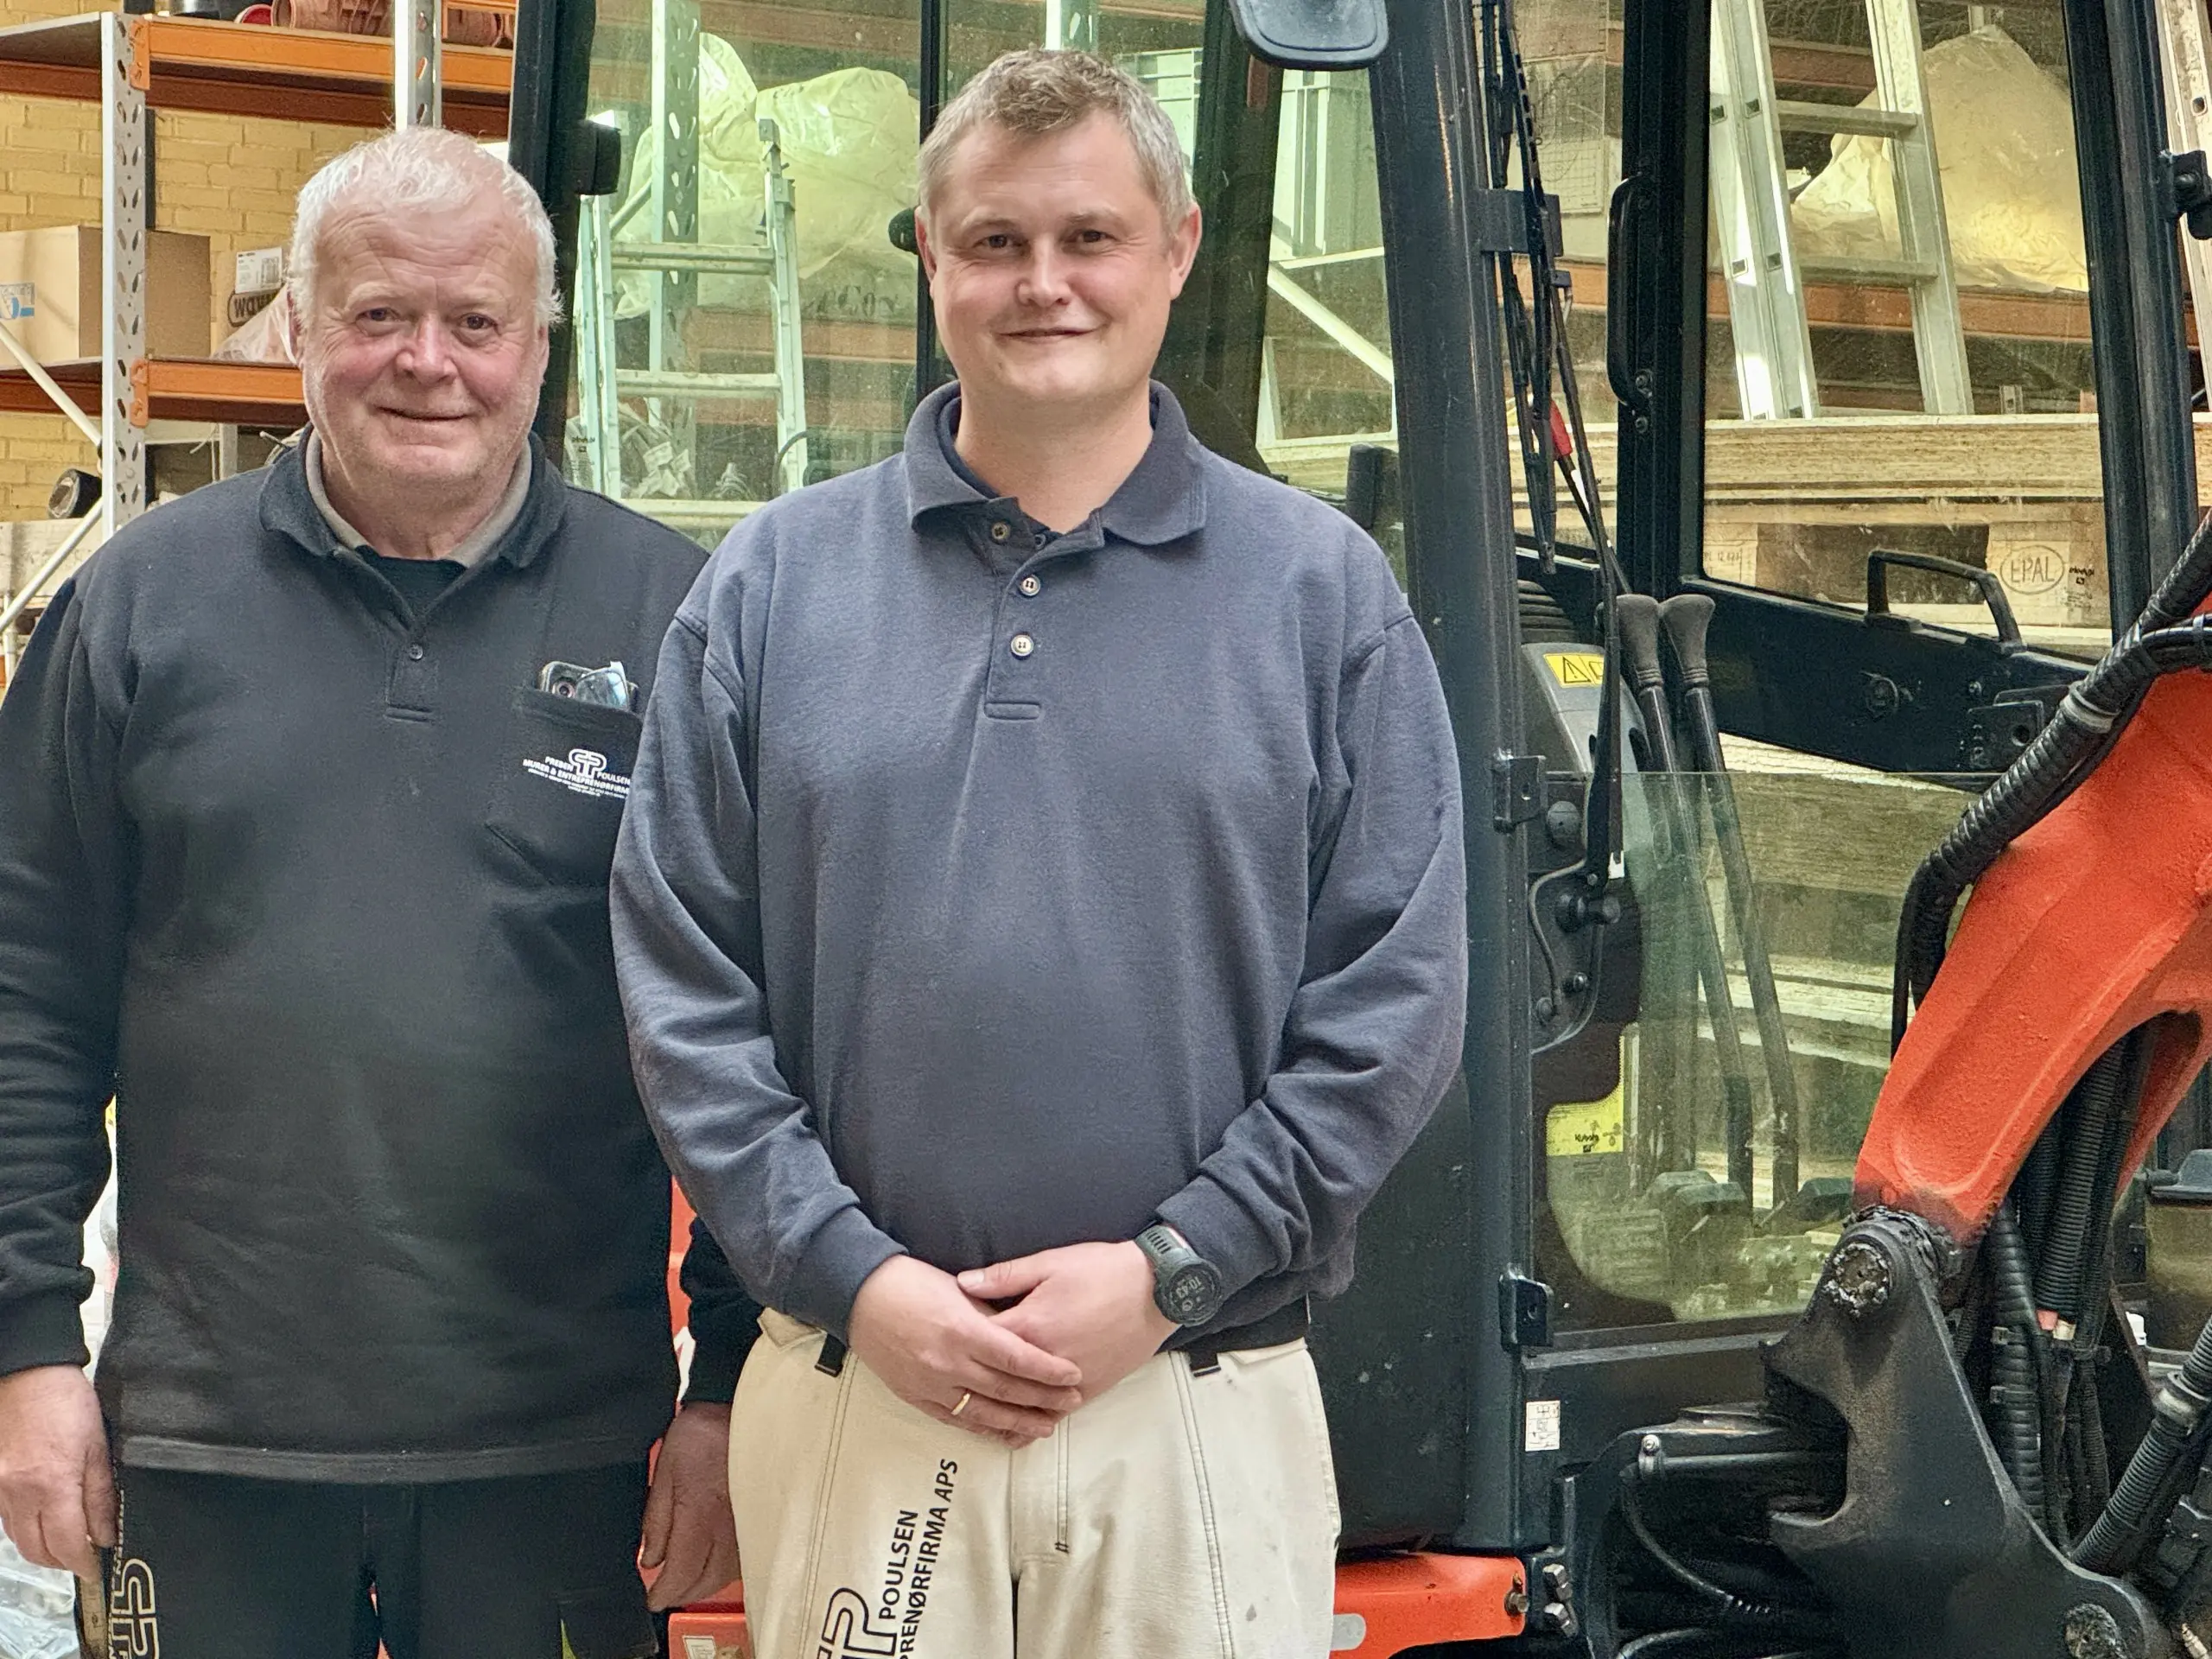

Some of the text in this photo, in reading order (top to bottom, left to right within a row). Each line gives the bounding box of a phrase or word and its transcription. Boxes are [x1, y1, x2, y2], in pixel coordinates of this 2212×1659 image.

[2011, 556, 2055, 583] EPAL
[597, 772, 630, 785] POULSEN
[934, 1459, 958, 1503] APS
[879, 1510, 918, 1619] POULSEN
